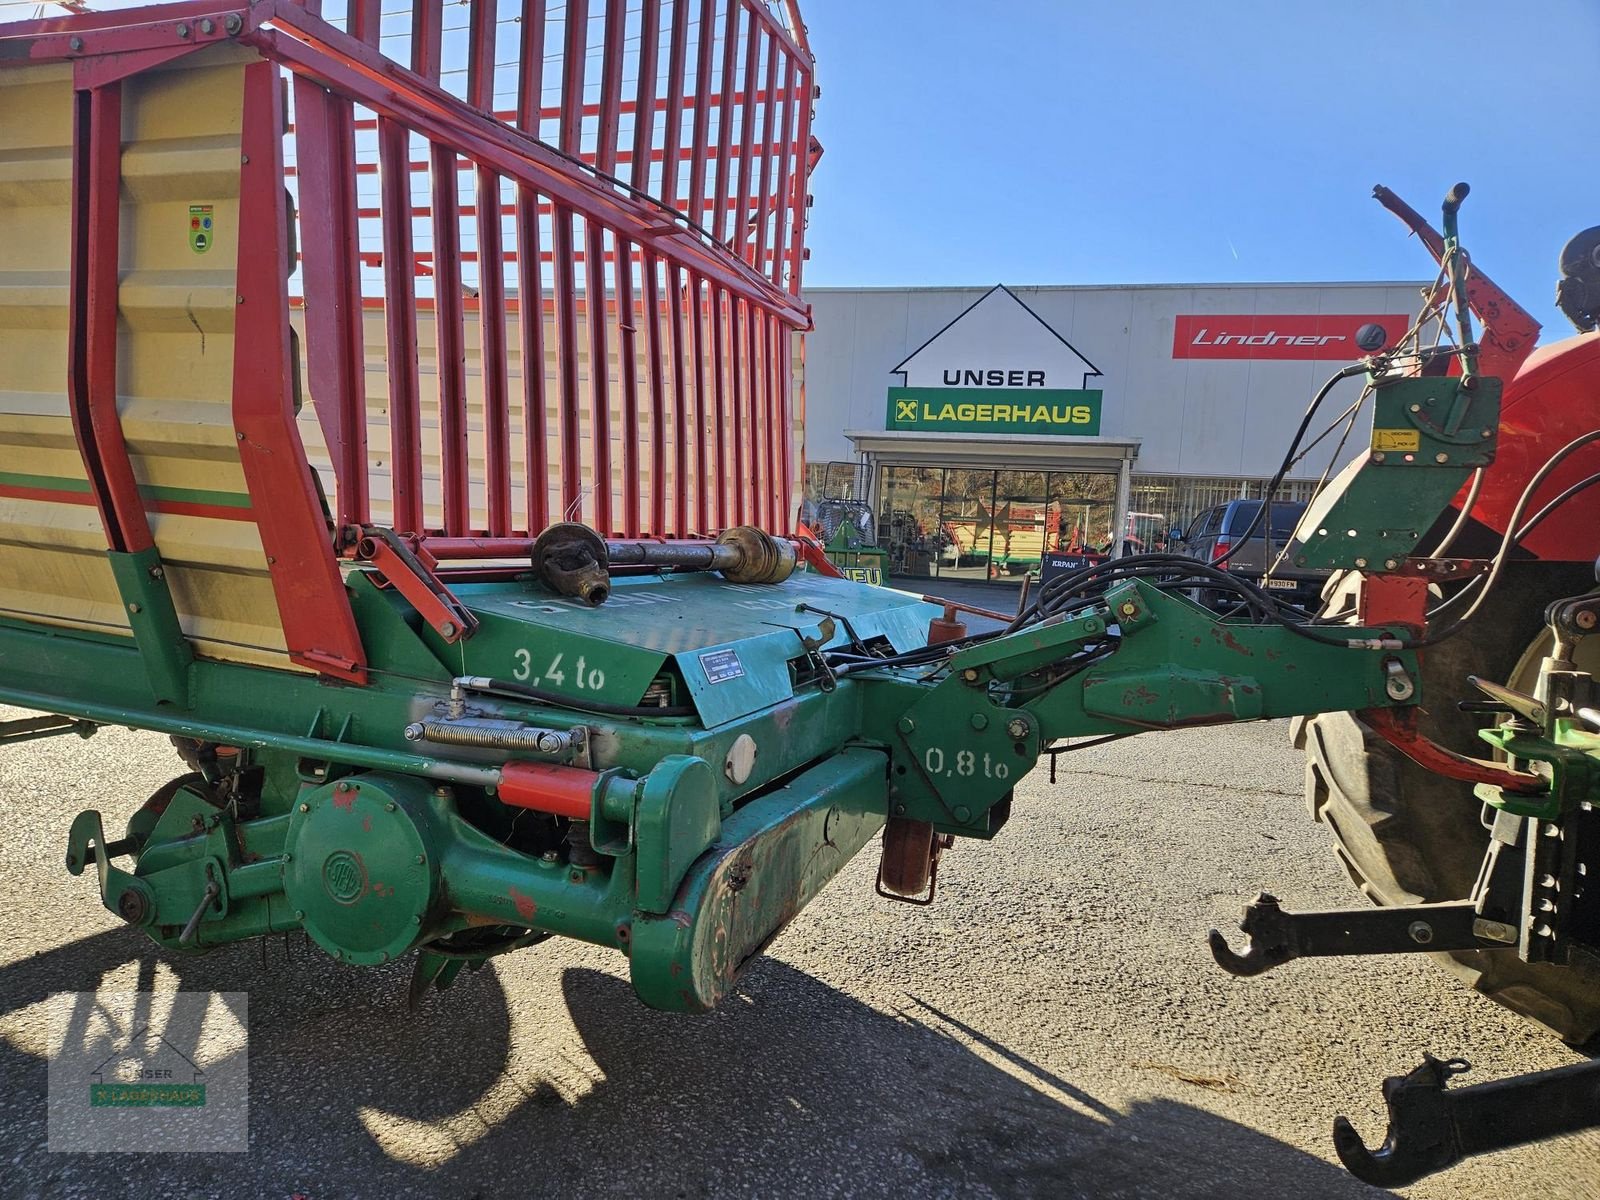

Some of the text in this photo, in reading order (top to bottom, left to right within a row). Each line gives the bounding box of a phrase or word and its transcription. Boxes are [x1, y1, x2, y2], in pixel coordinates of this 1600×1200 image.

[1192, 329, 1346, 346] Lindner
[943, 369, 1046, 387] UNSER
[923, 403, 1091, 424] LAGERHAUS
[1052, 560, 1076, 569] KRPAN
[512, 648, 605, 690] 3,4 to
[925, 747, 1009, 779] 0,8 to
